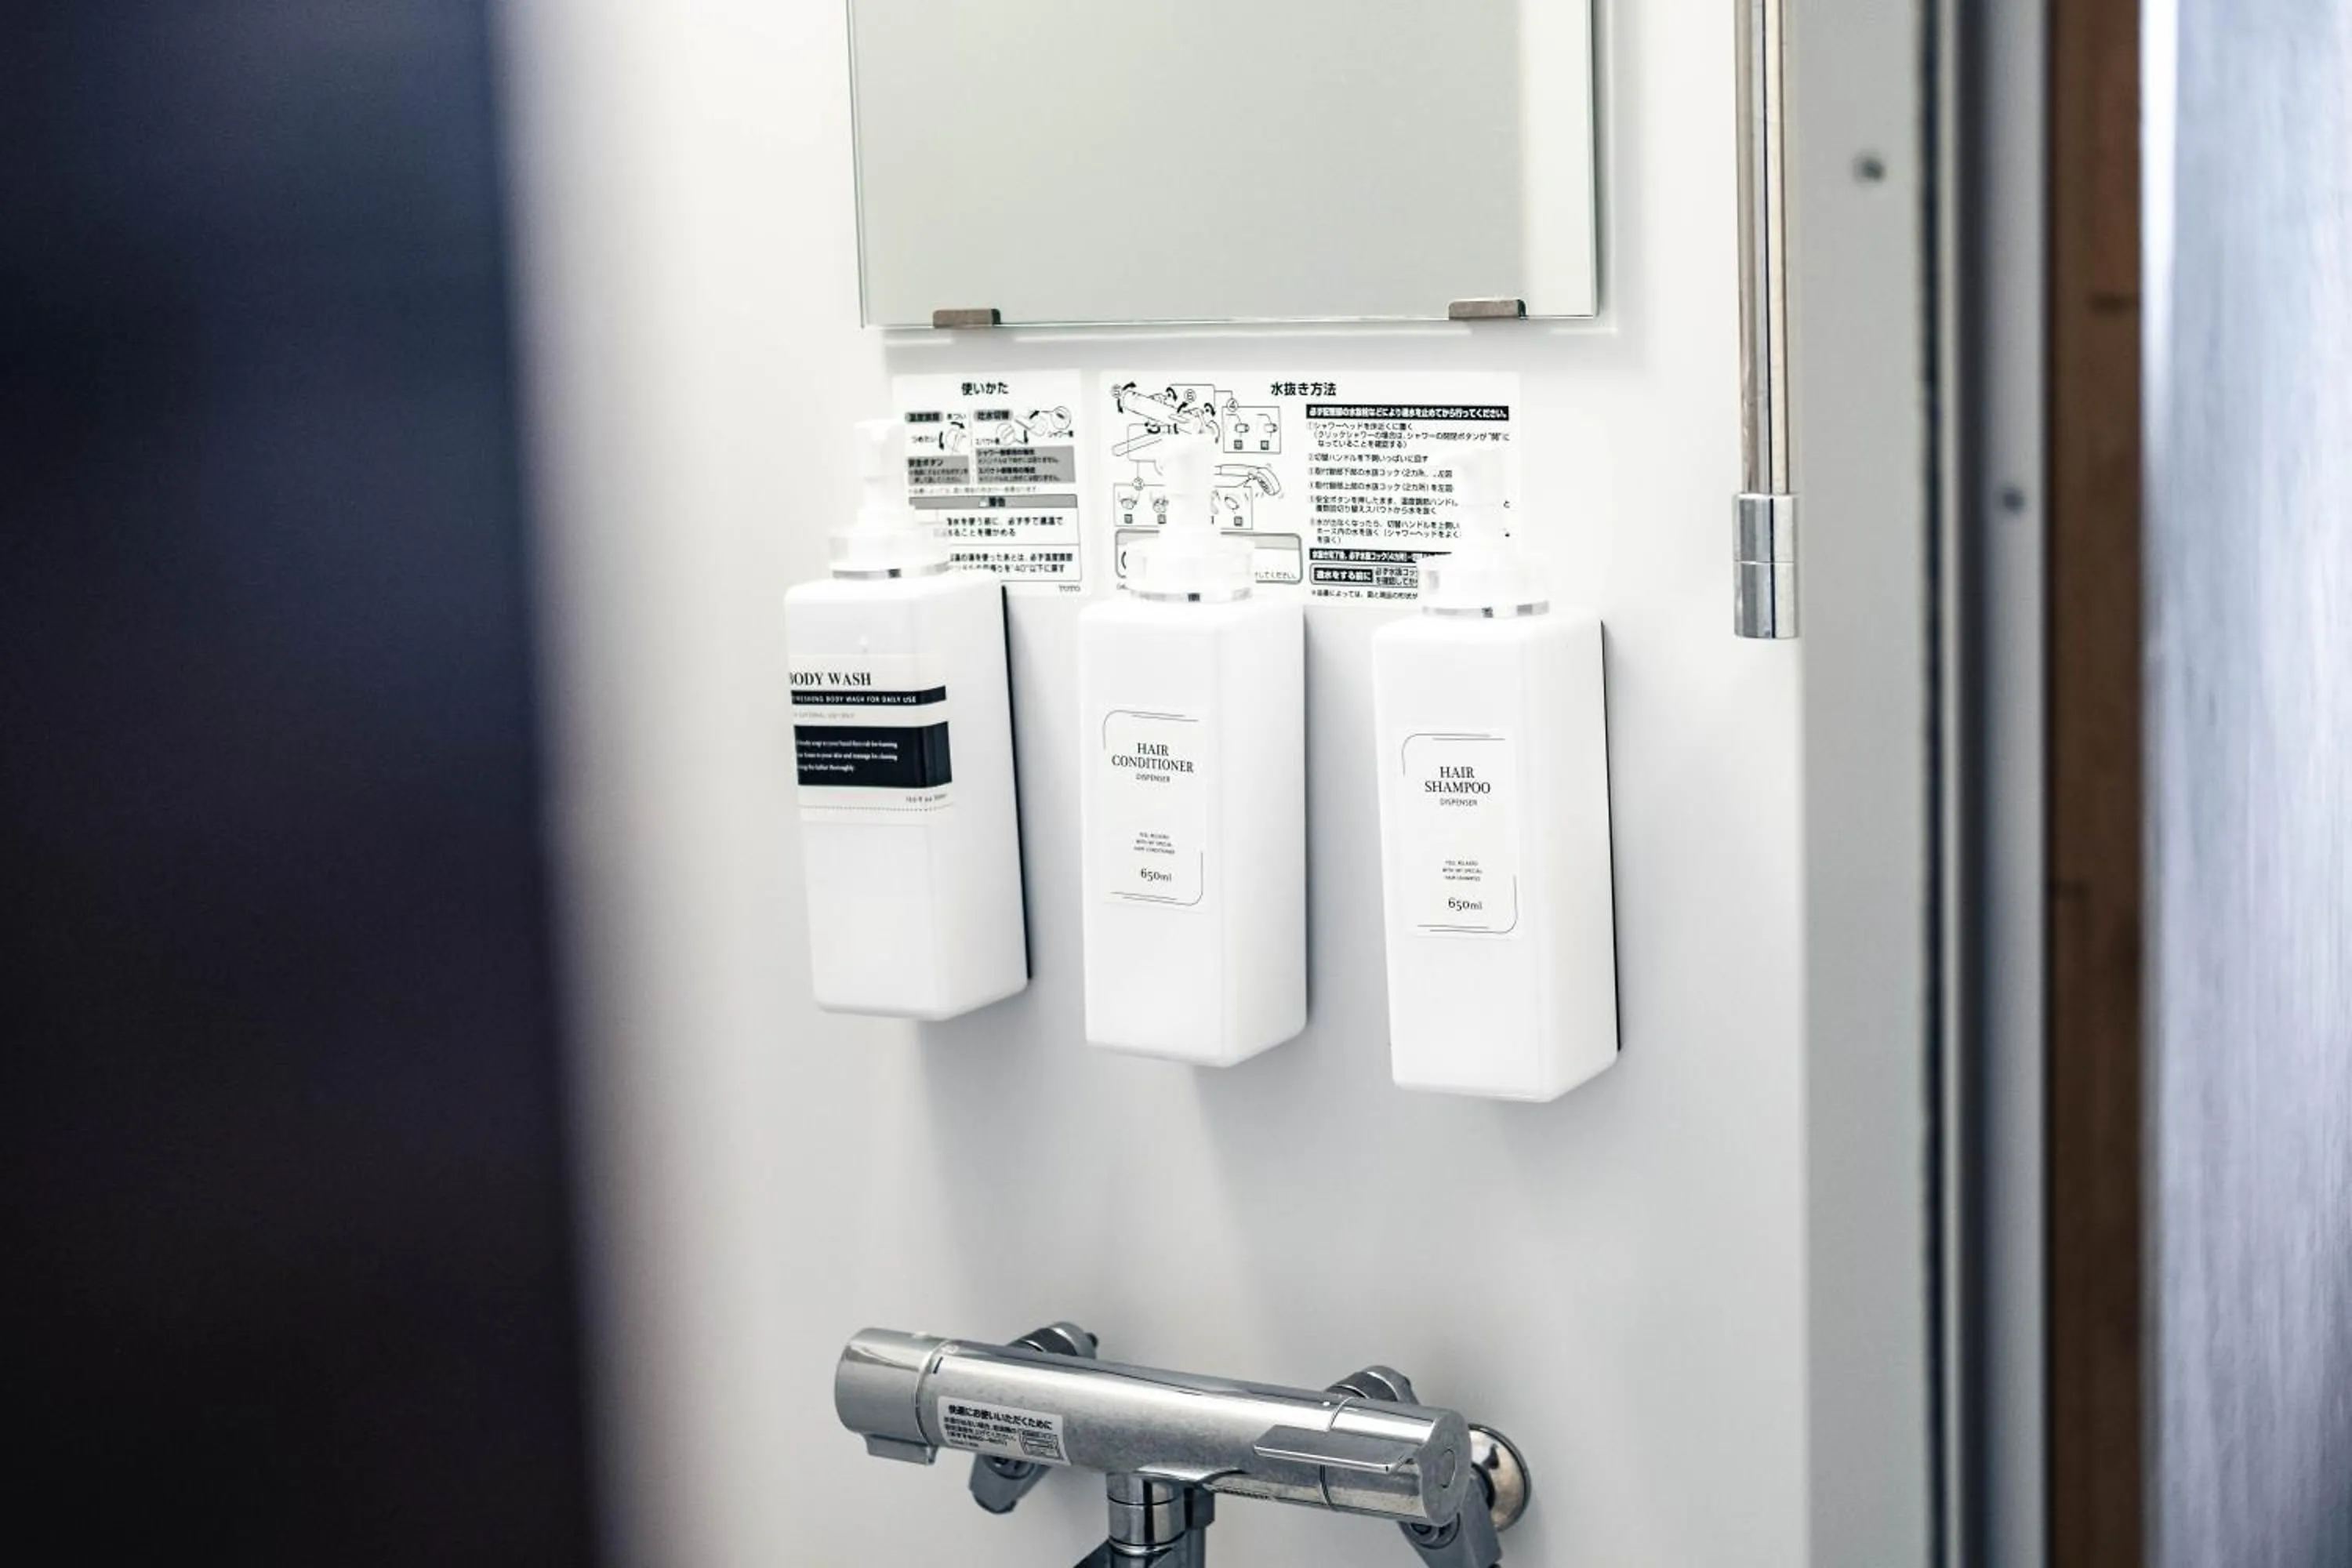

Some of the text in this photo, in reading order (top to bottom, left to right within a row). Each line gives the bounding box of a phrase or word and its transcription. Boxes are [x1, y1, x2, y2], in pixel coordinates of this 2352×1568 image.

[961, 382, 1009, 396] 使いかた
[1270, 382, 1337, 397] 水抜き方法
[828, 672, 872, 686] WASH
[826, 695, 844, 703] BODY
[846, 695, 864, 703] WASH
[867, 695, 880, 703] FOR
[1137, 742, 1169, 757] HAIR
[1112, 755, 1194, 773] CONDITIONER
[1135, 773, 1171, 783] DISPENSER
[1439, 766, 1475, 779] HAIR
[1425, 780, 1491, 794] SHAMPOO
[1439, 797, 1478, 807] DISPENSER
[1141, 868, 1172, 882] 650ml
[1448, 898, 1483, 911] 650ml
